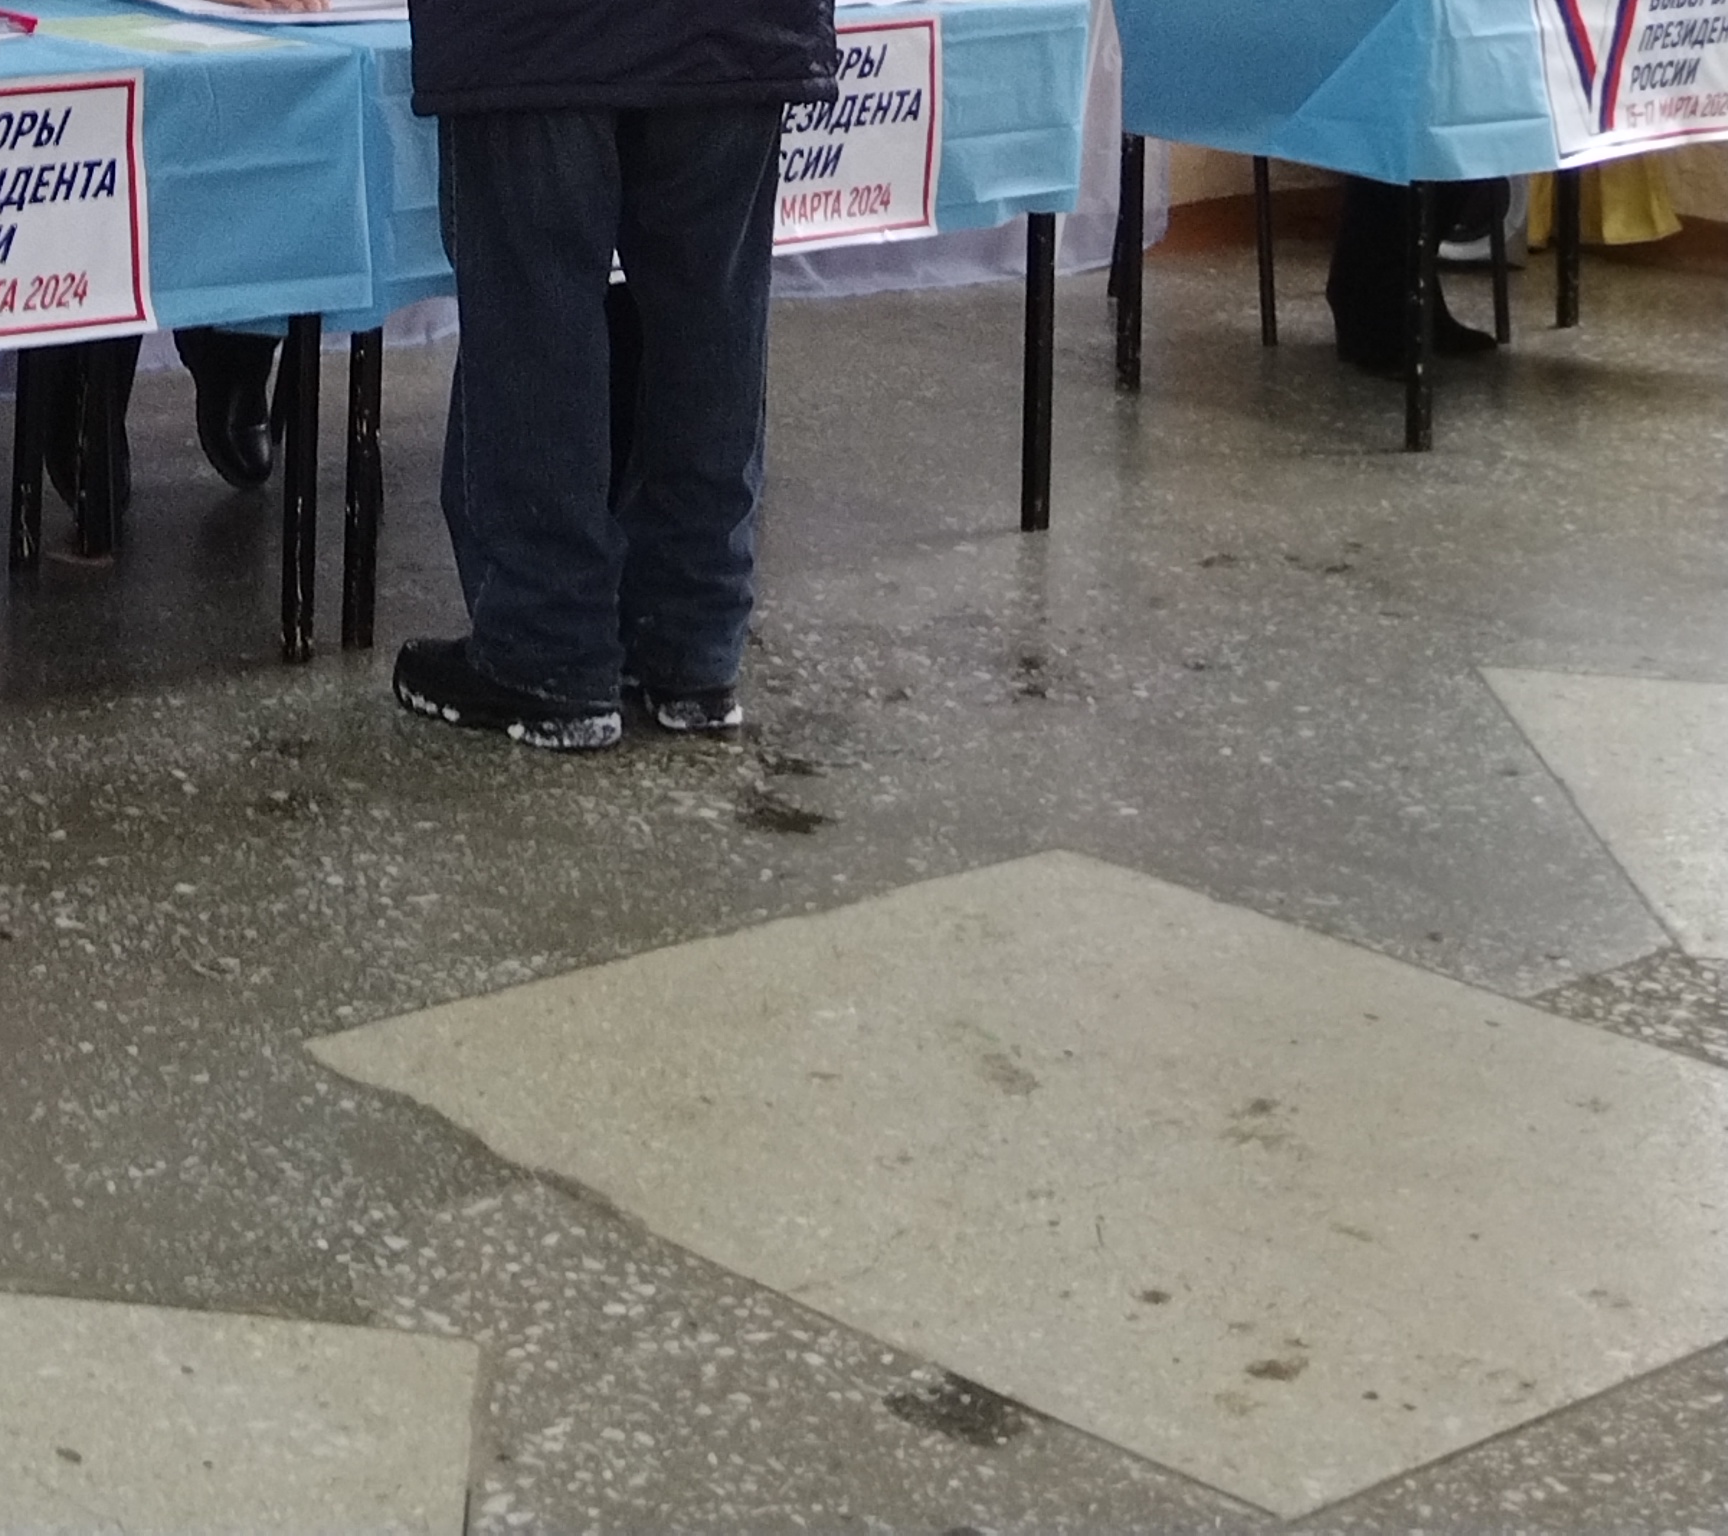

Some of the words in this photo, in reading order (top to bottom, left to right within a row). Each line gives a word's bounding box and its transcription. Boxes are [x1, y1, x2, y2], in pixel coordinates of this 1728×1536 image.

[1629, 58, 1701, 92] РОССИИ
[780, 189, 842, 226] МАРТА
[846, 182, 892, 218] 2024
[23, 270, 90, 312] 2024
